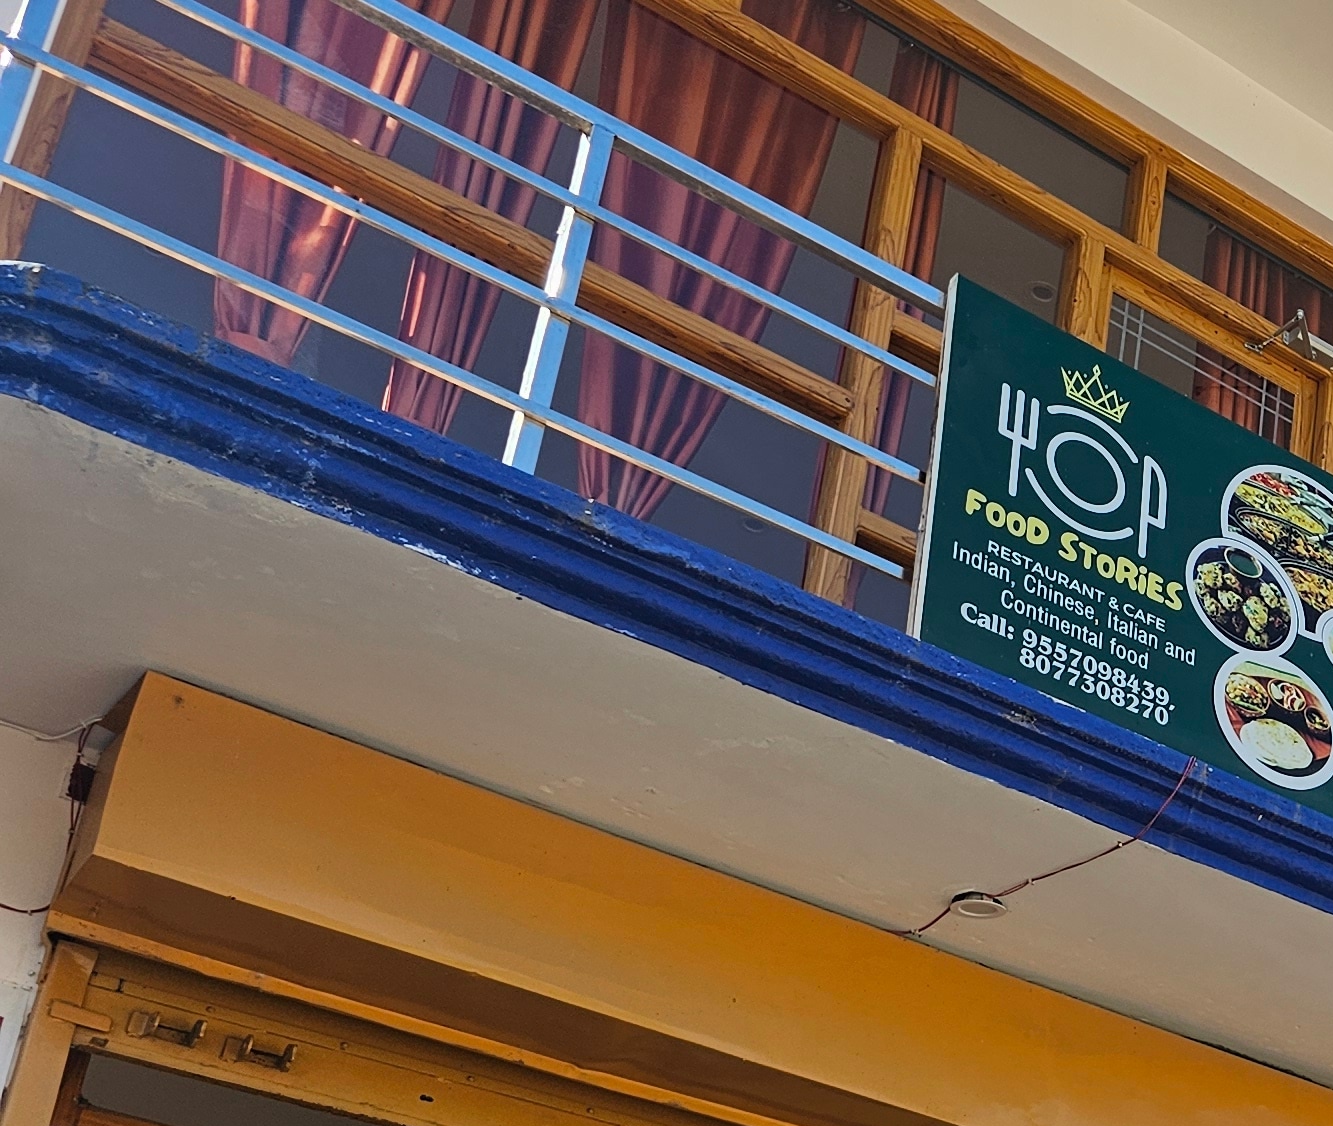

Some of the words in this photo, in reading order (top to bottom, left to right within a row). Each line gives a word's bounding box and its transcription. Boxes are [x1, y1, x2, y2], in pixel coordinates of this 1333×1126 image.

[965, 488, 1049, 545] FOOD
[952, 541, 1015, 588] Indian,
[1024, 574, 1099, 625] Chinese,
[1107, 612, 1158, 649] Italian
[1165, 641, 1196, 666] and
[988, 540, 1105, 602] RESTAURANT
[1108, 597, 1120, 612] &
[1123, 603, 1166, 632] CAFE
[960, 602, 1015, 640] Call:
[1022, 629, 1175, 712] 9557098439,
[1001, 590, 1103, 649] Continental
[1110, 638, 1149, 670] food
[1020, 648, 1169, 725] 8077308270
